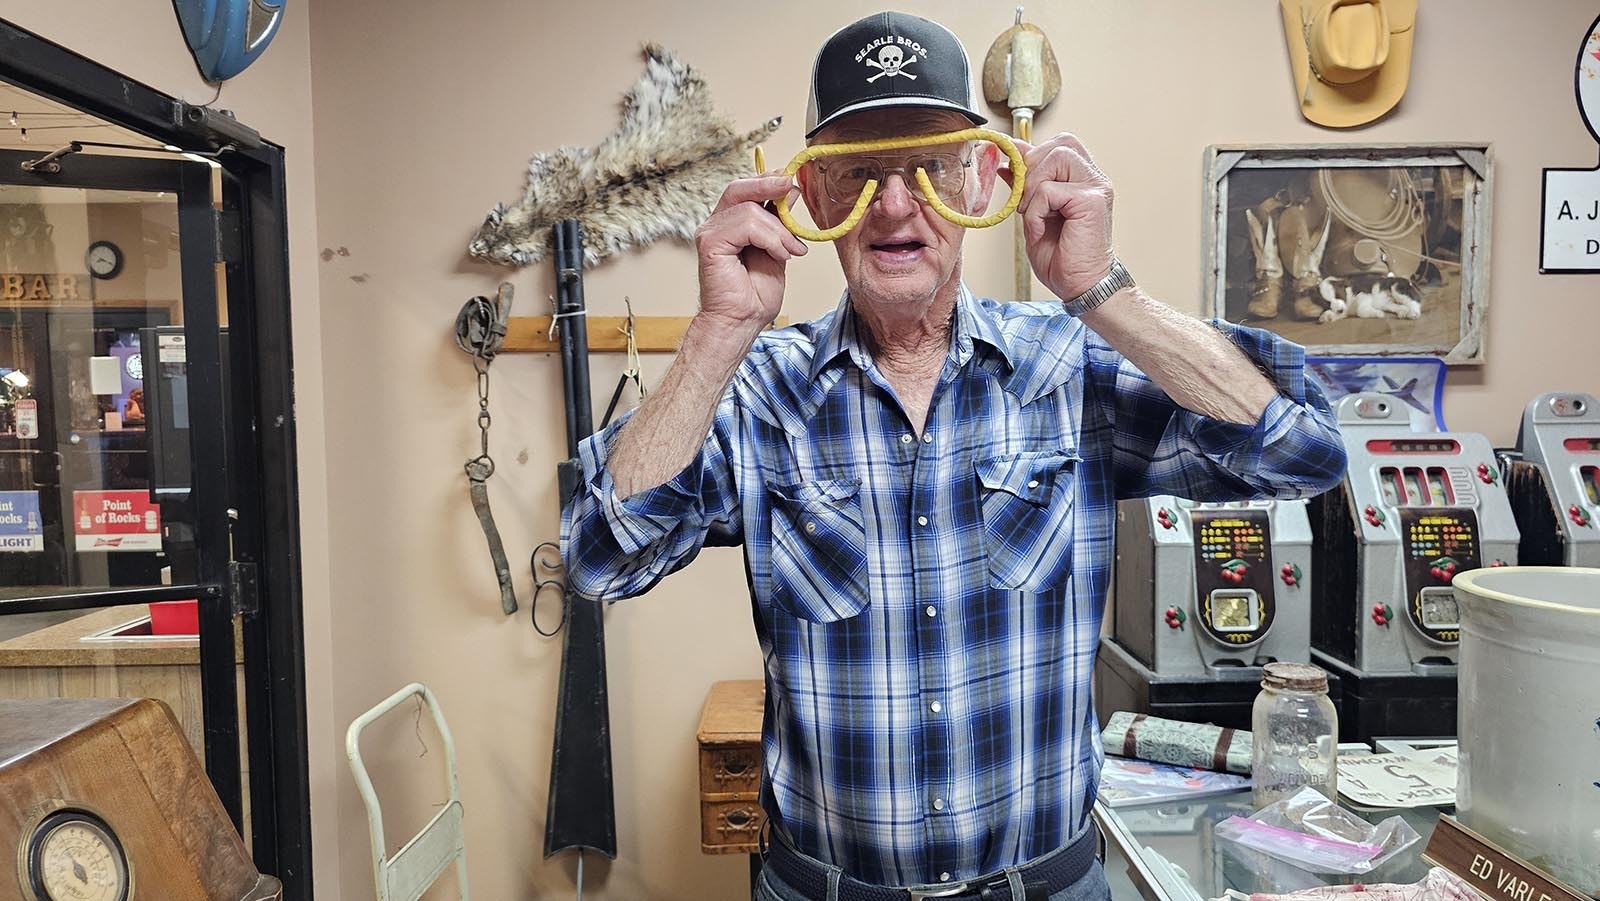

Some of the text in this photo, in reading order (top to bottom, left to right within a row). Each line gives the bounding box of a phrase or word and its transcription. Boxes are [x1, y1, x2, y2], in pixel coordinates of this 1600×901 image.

[855, 36, 928, 63] SEARLE BROS.
[1557, 199, 1579, 220] A.
[2, 274, 78, 299] BAR
[0, 500, 14, 512] int
[102, 500, 132, 511] Point
[0, 513, 23, 524] ocks
[95, 512, 142, 524] of Rocks
[1336, 754, 1411, 766] WYOMIN
[1469, 854, 1493, 880] ED
